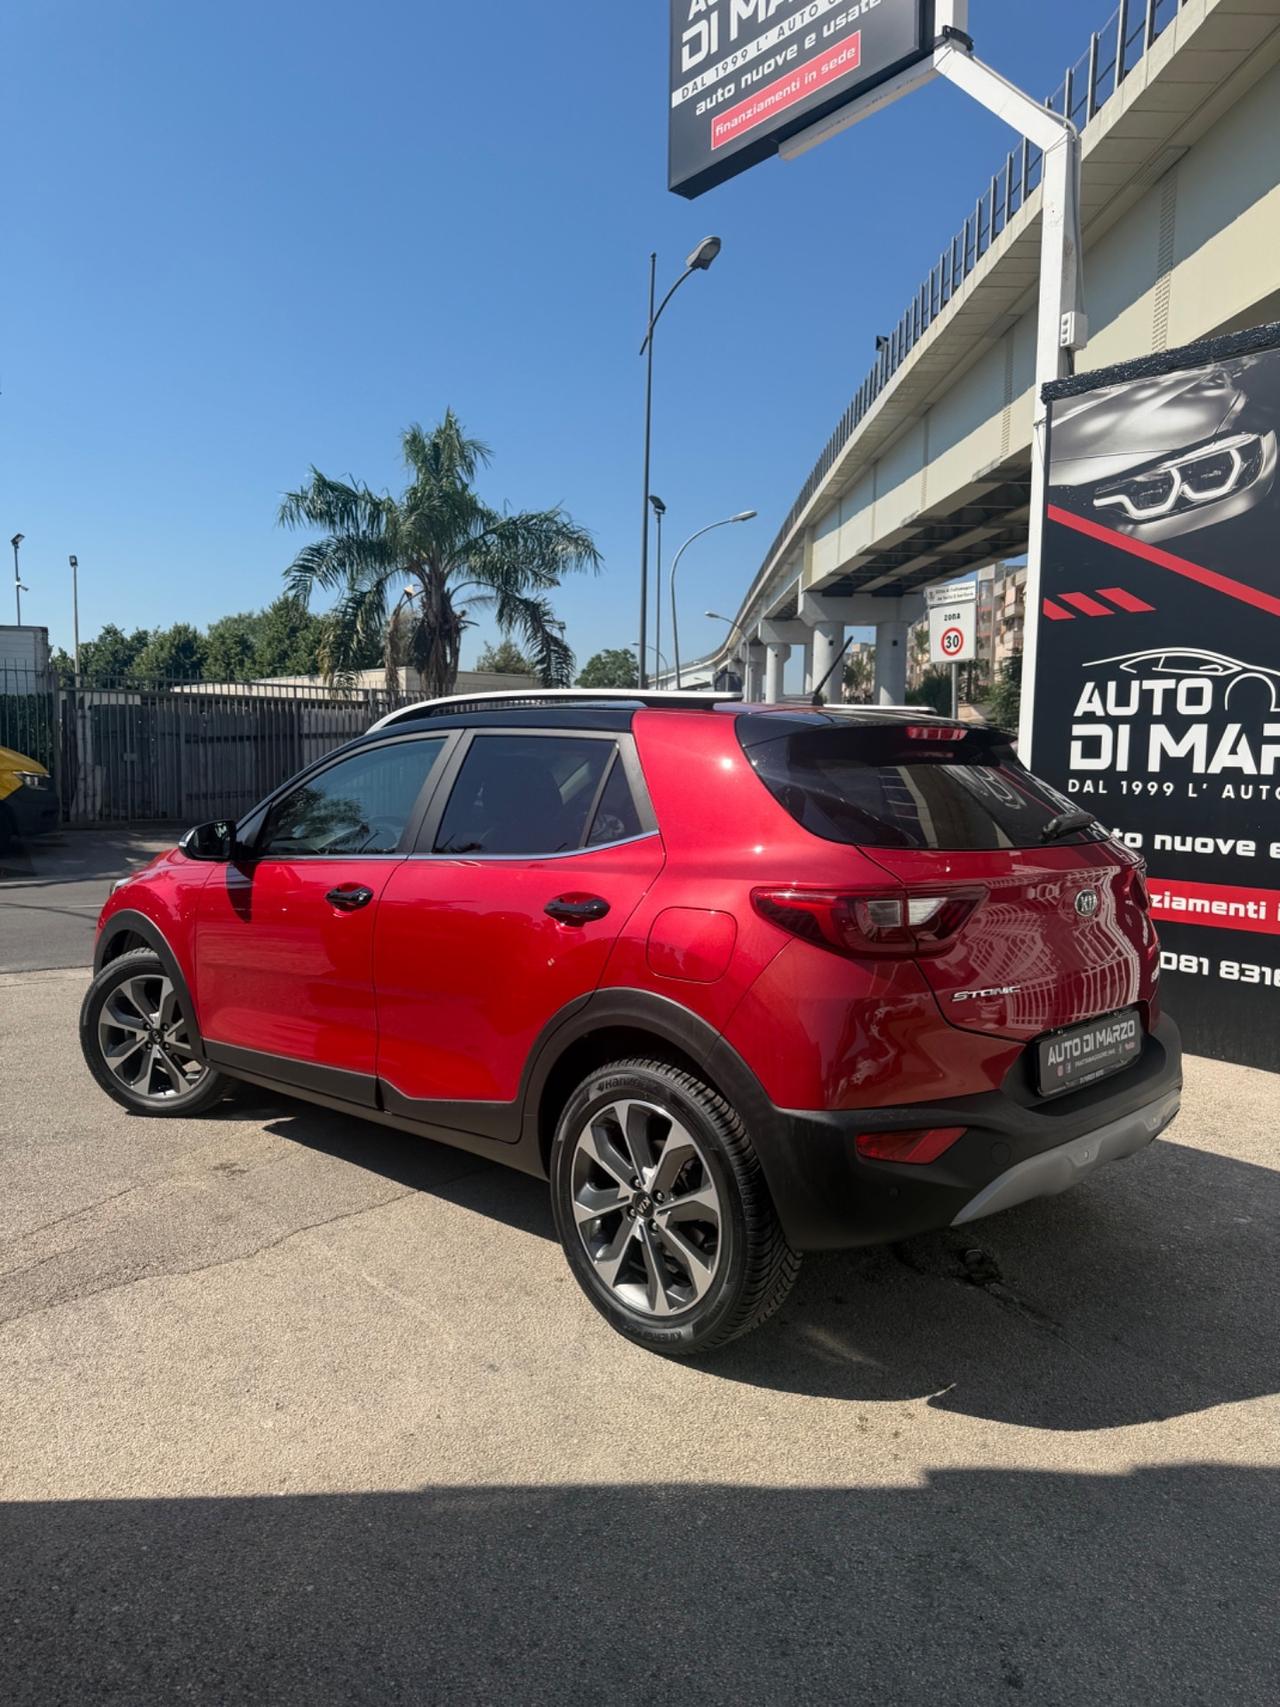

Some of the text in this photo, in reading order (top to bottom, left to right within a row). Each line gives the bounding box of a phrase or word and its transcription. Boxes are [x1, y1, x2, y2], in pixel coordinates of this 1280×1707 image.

[681, 79, 707, 99] DAL
[715, 49, 748, 78] 1999
[777, 5, 818, 37] AUTO
[682, 10, 718, 73] DI
[695, 82, 735, 116] auto
[741, 47, 798, 89] nuove
[804, 32, 817, 50] e
[715, 47, 856, 137] finanziamenti in sede
[945, 634, 960, 649] 30
[1073, 677, 1213, 717] AUTO
[1069, 724, 1131, 771] DI
[1068, 778, 1108, 794] DAL
[1120, 780, 1175, 797] 1999
[1154, 833, 1257, 858] nuove
[1159, 951, 1209, 977] 081
[952, 985, 1021, 1002] STONIC
[1047, 1038, 1081, 1066] AUTO
[1083, 1032, 1095, 1053] DI
[1096, 1020, 1135, 1049] MARZO
